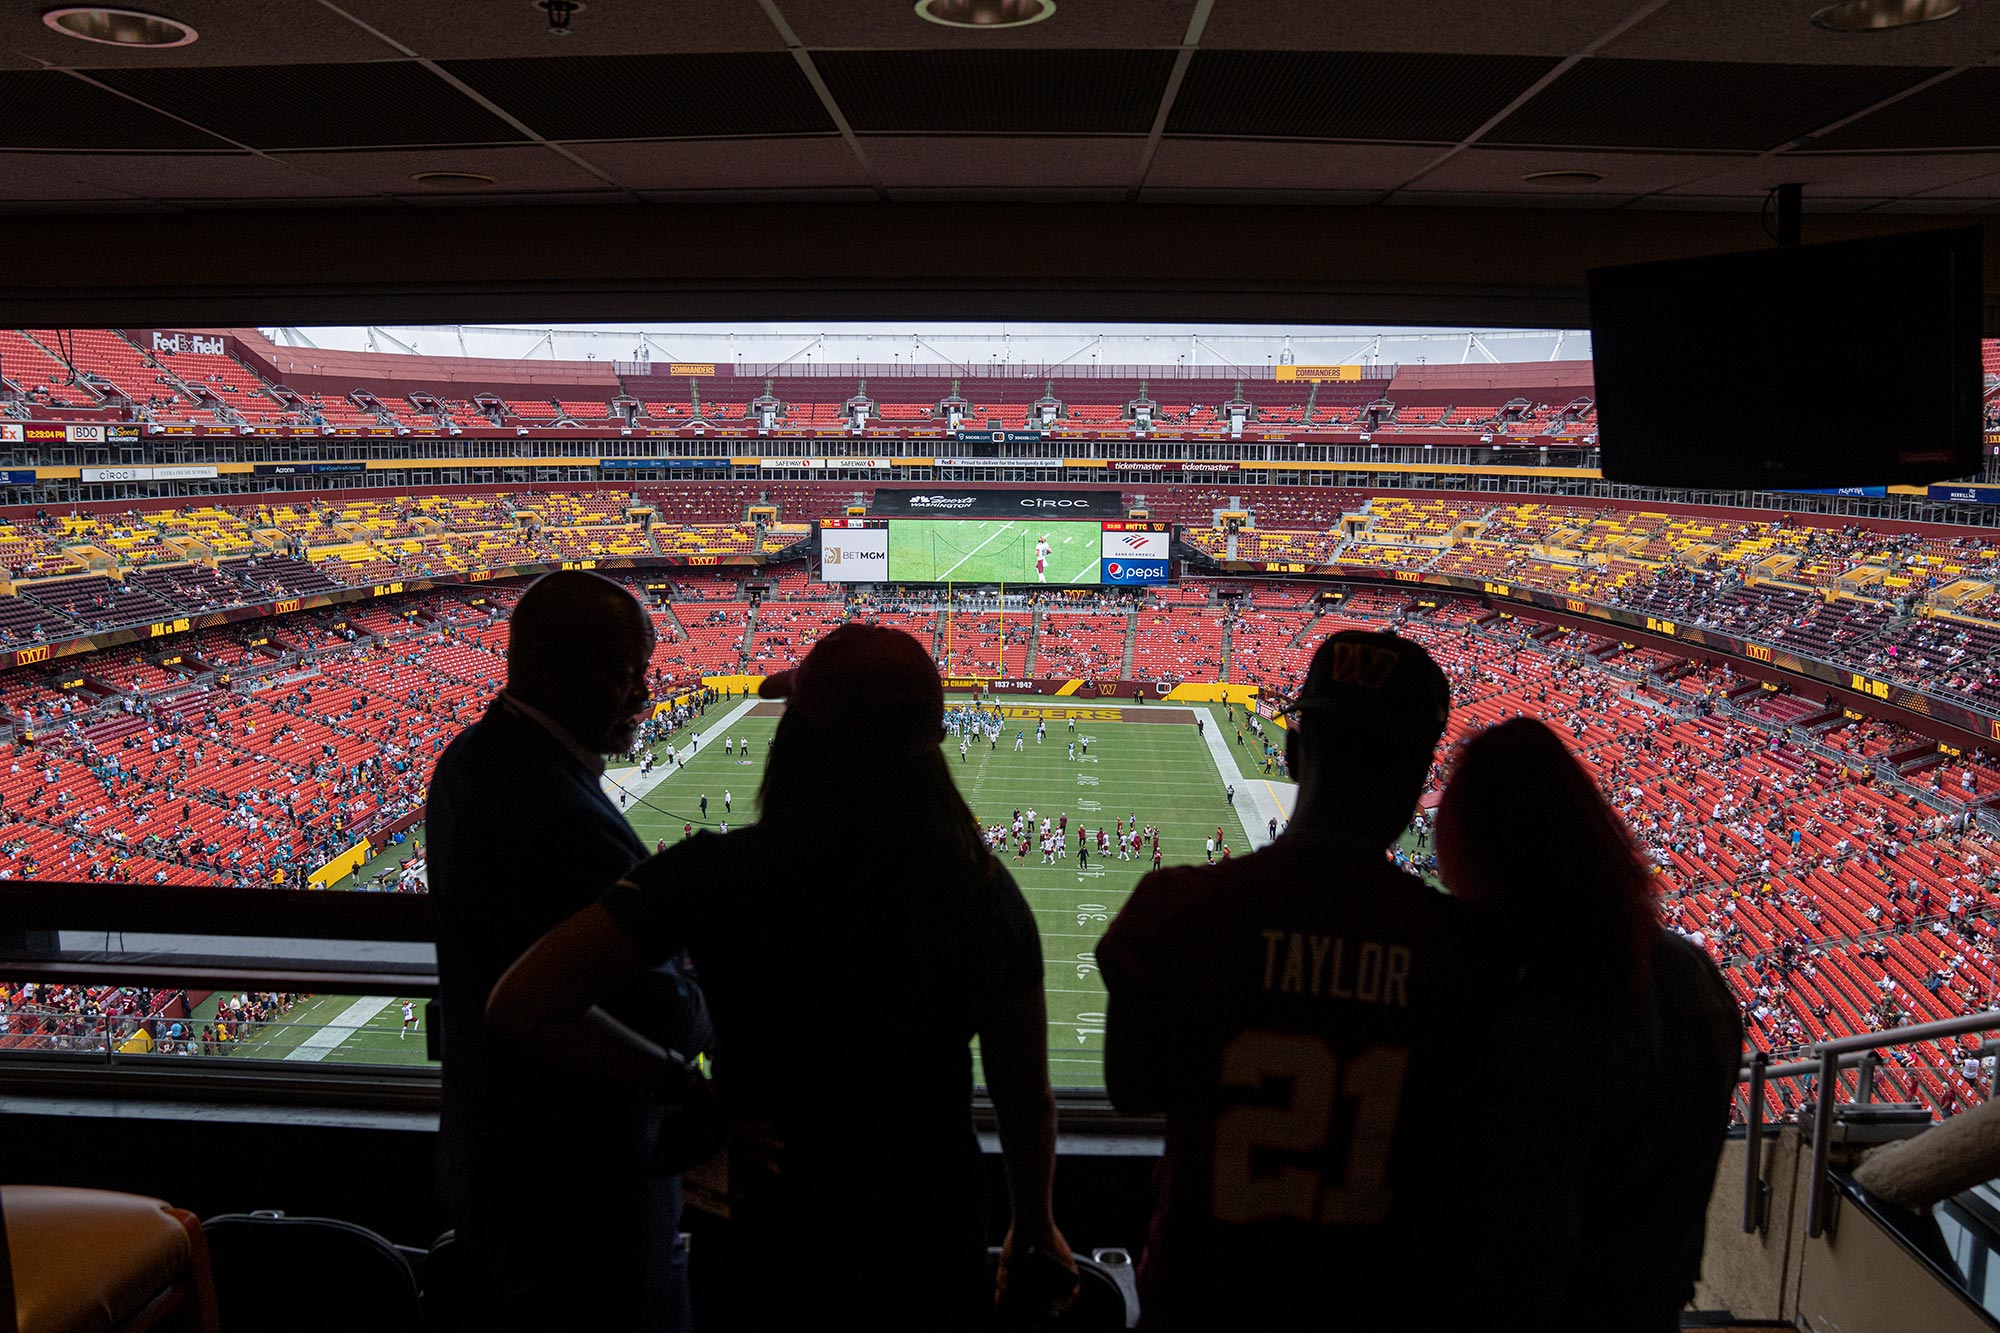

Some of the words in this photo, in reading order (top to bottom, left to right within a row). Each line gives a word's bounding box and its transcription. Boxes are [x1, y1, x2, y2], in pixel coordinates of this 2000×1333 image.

[670, 366, 715, 374] COMMANDERS
[1295, 369, 1341, 377] COMMANDERS
[0, 425, 17, 440] Ex
[75, 427, 98, 438] BDO
[1115, 461, 1164, 470] ticketmaster
[1181, 462, 1230, 471] ticketmaster
[1125, 522, 1148, 530] #HTTC
[842, 551, 885, 560] BETMGM
[562, 561, 574, 571] JAX
[581, 559, 596, 570] WAS
[1266, 562, 1280, 571] JAX
[1289, 563, 1306, 573] WAS
[150, 622, 165, 637] JAX
[173, 618, 190, 633] WAS
[1016, 681, 1033, 689] 1942
[1851, 673, 1865, 691] JAX
[1872, 679, 1889, 699] WAS
[1077, 903, 1108, 922] 30
[1259, 928, 1411, 1009] TAYLOR
[1076, 1012, 1107, 1035] 10
[1211, 1027, 1409, 1227] 21
